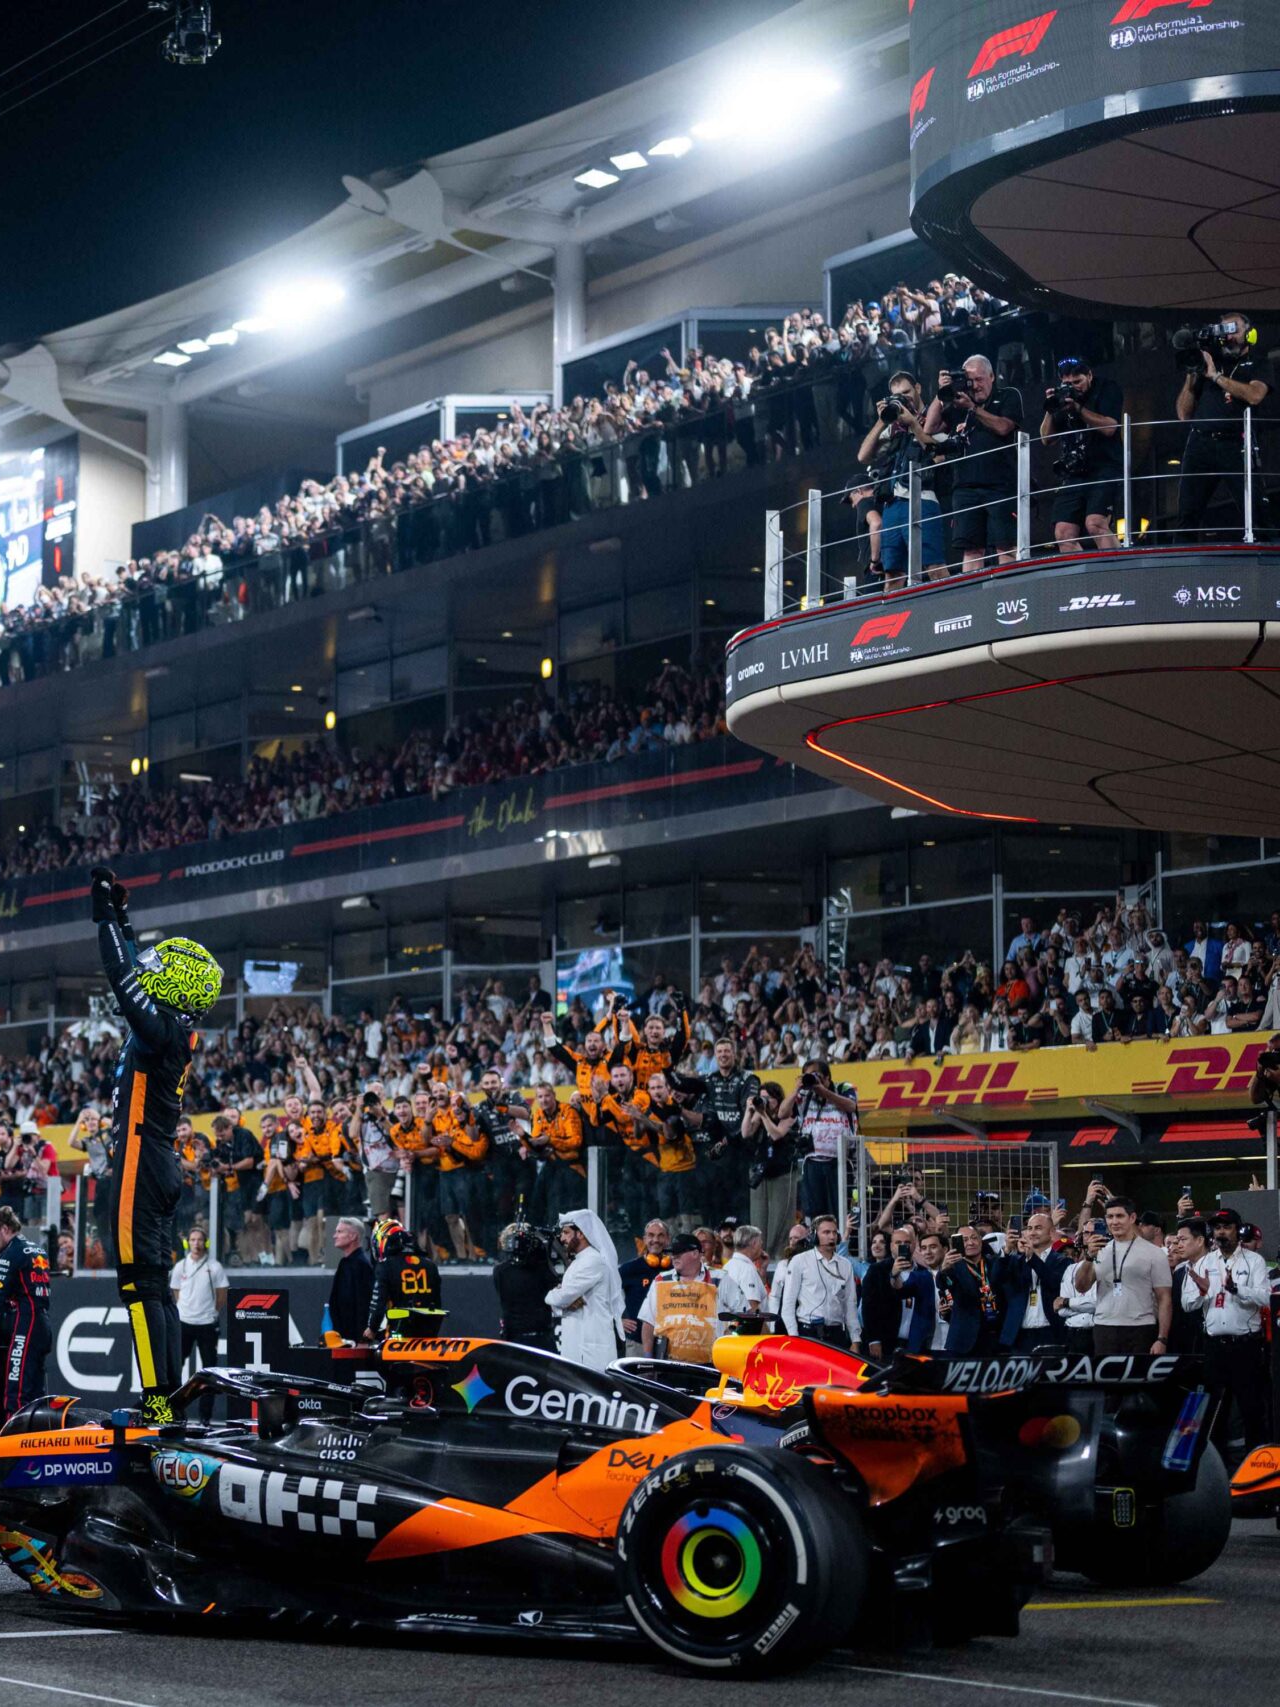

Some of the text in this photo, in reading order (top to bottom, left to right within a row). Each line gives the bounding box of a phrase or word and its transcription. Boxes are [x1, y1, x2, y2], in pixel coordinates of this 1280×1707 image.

[1137, 15, 1203, 34] FIA Formula 1
[1138, 20, 1240, 43] World Championship
[967, 10, 1058, 79] F1
[1110, 29, 1134, 47] FIA
[986, 62, 1057, 94] World Championship
[998, 65, 1027, 80] Formula
[967, 82, 985, 100] FIA
[1069, 594, 1124, 610] DHL
[1196, 586, 1241, 600] MSC
[996, 598, 1028, 616] aws
[850, 611, 912, 646] F1
[934, 615, 972, 634] PIRELLI
[781, 643, 829, 670] LVMH
[737, 662, 764, 681] aramco
[185, 856, 247, 877] PADDOCK
[248, 849, 284, 865] CLUB
[876, 1061, 1029, 1109] DHL
[1070, 1127, 1117, 1148] F1
[401, 1268, 431, 1294] 81
[236, 1294, 280, 1309] F1
[8, 1335, 26, 1381] Red Bull
[245, 1332, 270, 1373] 1
[387, 1340, 470, 1357] allwyn
[1045, 1356, 1180, 1383] RACLE
[298, 1399, 322, 1410] okta
[505, 1375, 659, 1433] Gemini
[843, 1405, 937, 1423] Dropbox
[20, 1434, 109, 1448] RICHARD MILLE
[780, 1426, 809, 1448] PIRELLI
[319, 1449, 356, 1460] CISCO
[608, 1448, 669, 1470] DEL
[44, 1461, 113, 1476] DP WORLD
[155, 1457, 203, 1488] VELO
[618, 1463, 684, 1561] P ZERO
[945, 1507, 987, 1524] groq
[754, 1603, 800, 1655] PIRELLI
